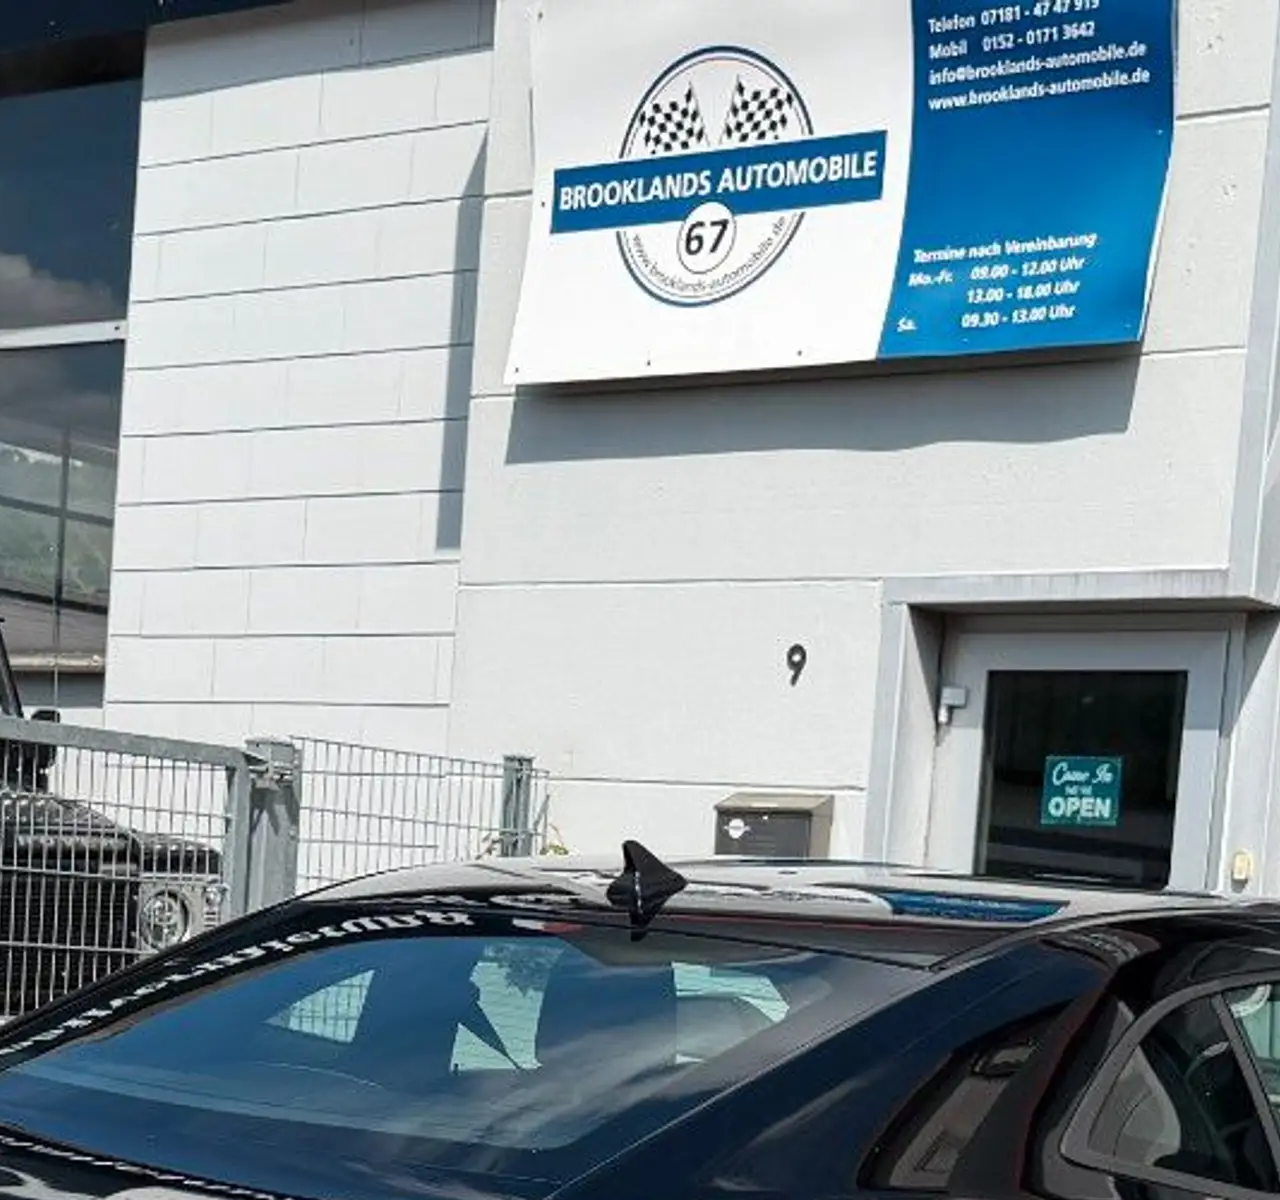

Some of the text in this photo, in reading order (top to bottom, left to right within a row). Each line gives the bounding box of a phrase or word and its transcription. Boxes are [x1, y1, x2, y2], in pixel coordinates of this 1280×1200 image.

[927, 14, 975, 33] Telefon
[981, 5, 1020, 25] 07181
[928, 39, 968, 59] Mobil
[982, 35, 1015, 52] 0152
[1026, 26, 1058, 45] 0171
[928, 41, 1147, 86] info@brooklands-automobile.de
[928, 67, 1150, 111] www.brooklands-automobile.de
[559, 151, 878, 211] BROOKLANDS AUTOMOBILE
[685, 218, 729, 256] 67
[913, 233, 1097, 263] Termine nach Vereinbarung
[1060, 256, 1085, 272] Uhr
[1053, 280, 1080, 296] Uhr
[1048, 304, 1076, 321] Uhr
[786, 643, 807, 687] 9
[1048, 796, 1111, 818] OPEN
